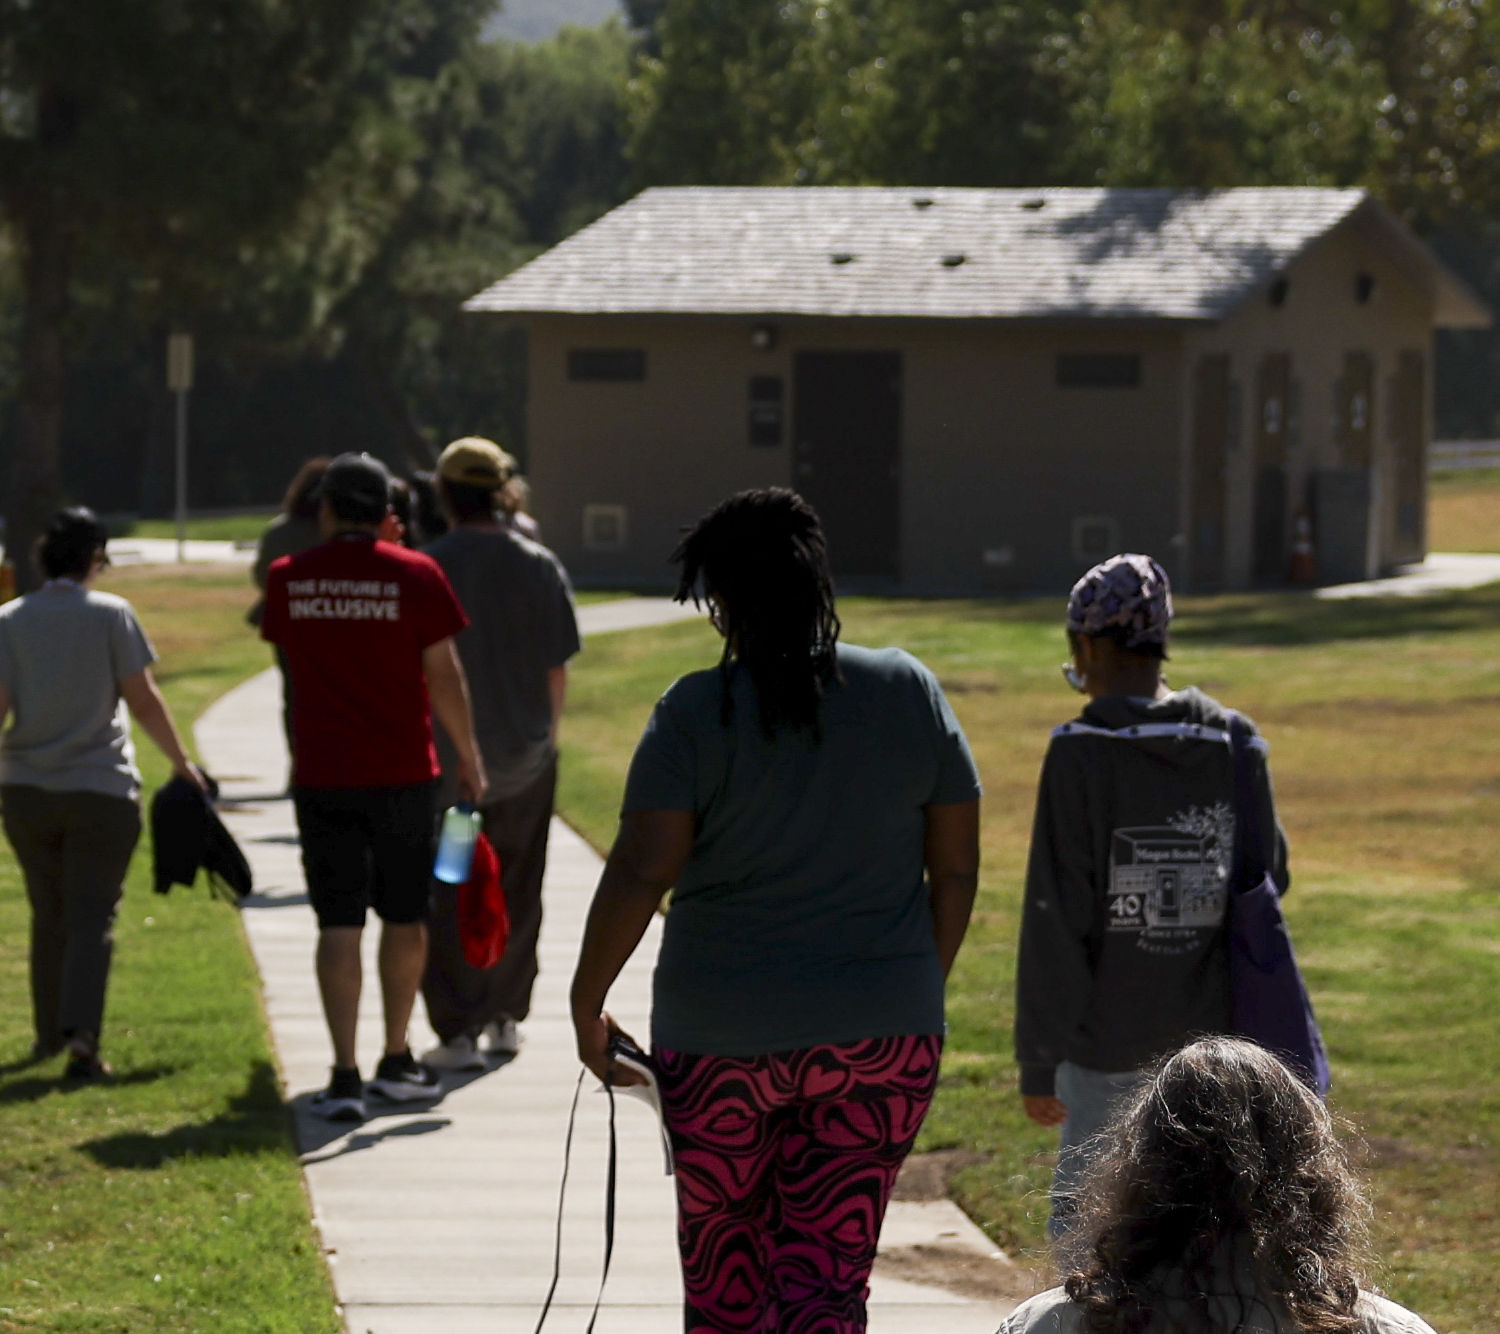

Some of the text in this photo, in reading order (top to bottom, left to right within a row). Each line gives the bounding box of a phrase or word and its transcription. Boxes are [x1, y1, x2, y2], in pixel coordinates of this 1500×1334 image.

[287, 579, 400, 598] THE FUTURE IS
[288, 598, 400, 622] INCLUSIVE
[1109, 894, 1141, 916] 40
